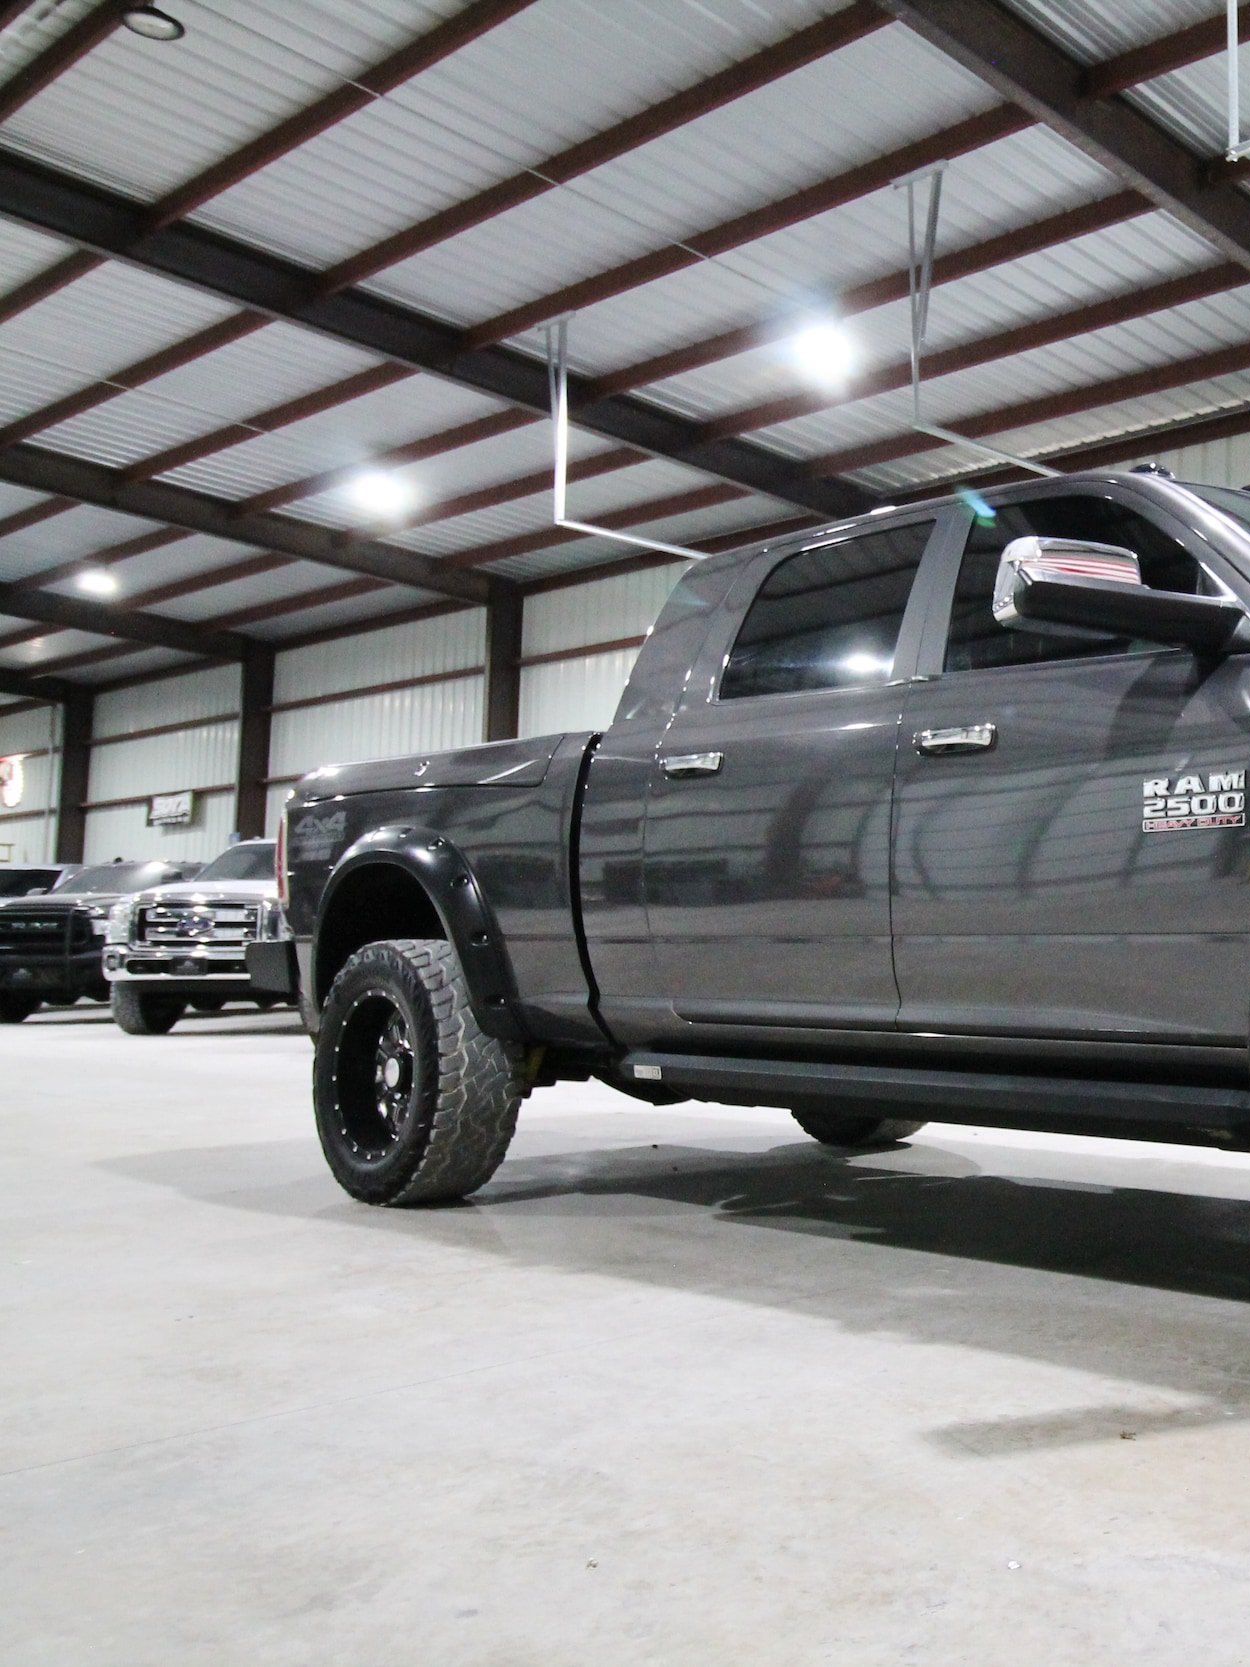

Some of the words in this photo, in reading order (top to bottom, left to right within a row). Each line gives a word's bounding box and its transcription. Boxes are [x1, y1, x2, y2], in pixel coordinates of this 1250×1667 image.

[1143, 770, 1246, 797] RAM
[1143, 791, 1245, 818] 2500
[1145, 818, 1197, 831] HEAVY
[1197, 815, 1242, 828] DUTY
